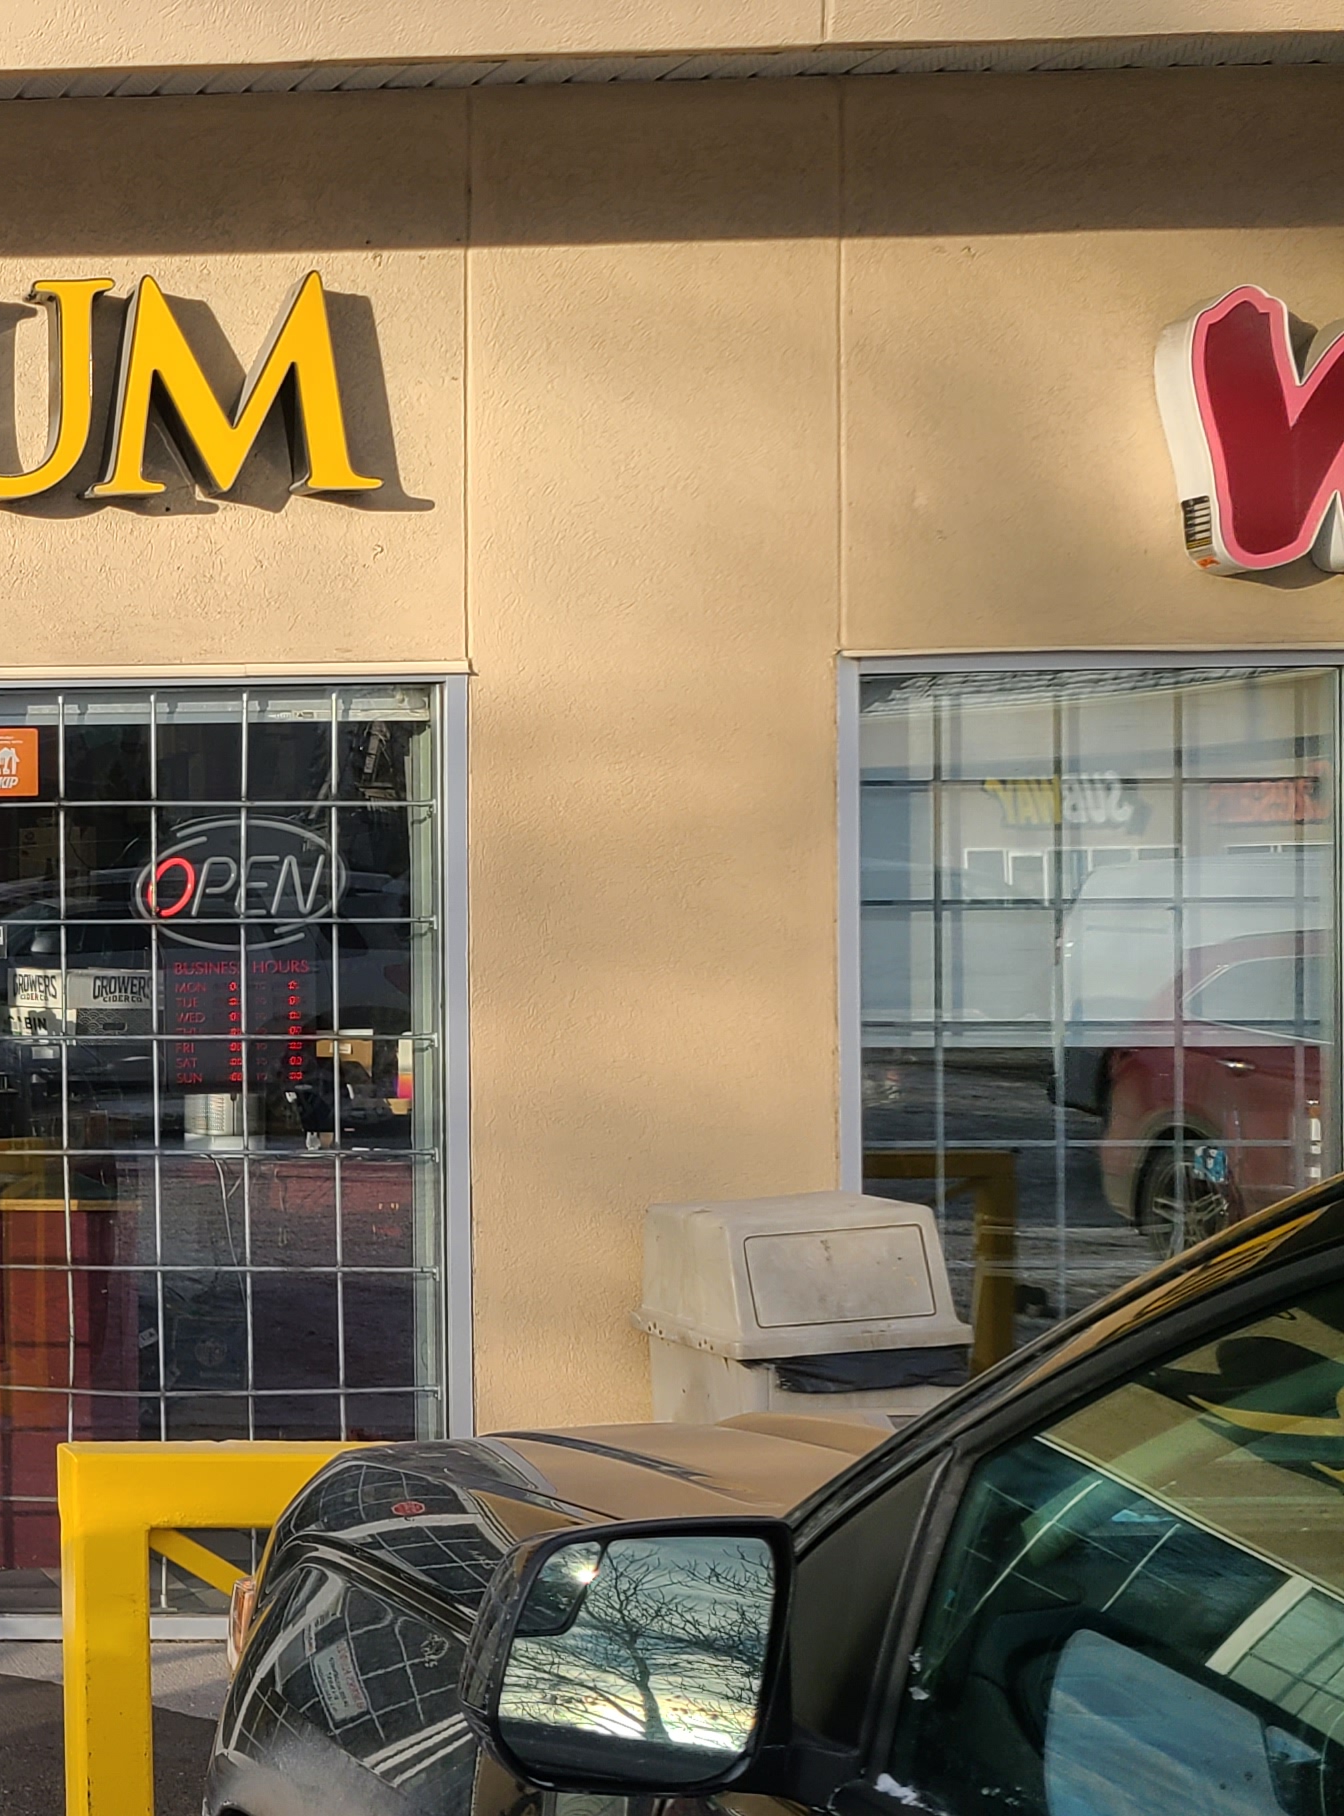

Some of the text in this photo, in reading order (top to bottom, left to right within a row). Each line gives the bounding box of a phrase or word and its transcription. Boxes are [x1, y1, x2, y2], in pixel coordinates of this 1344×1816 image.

[147, 855, 325, 917] OPEN
[174, 960, 310, 976] BUSINES HOURS
[13, 974, 58, 1000] GROWERS
[176, 1072, 204, 1084] SUN
